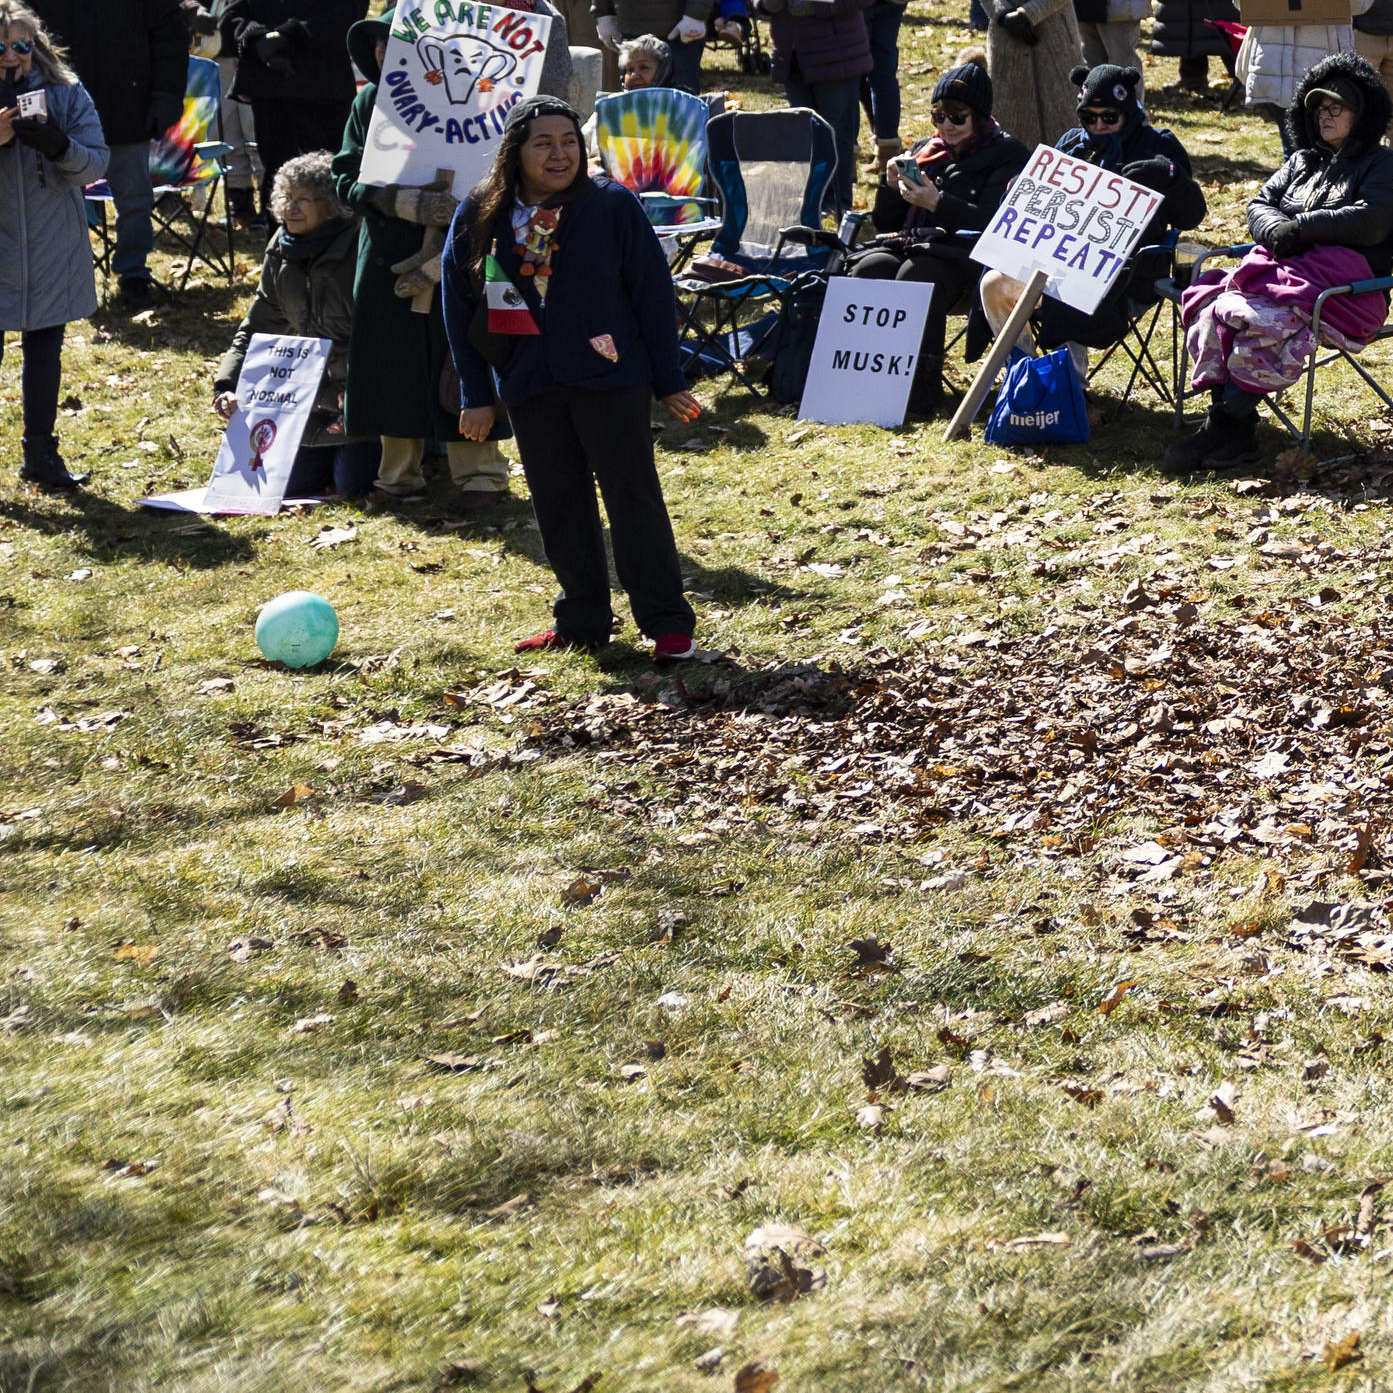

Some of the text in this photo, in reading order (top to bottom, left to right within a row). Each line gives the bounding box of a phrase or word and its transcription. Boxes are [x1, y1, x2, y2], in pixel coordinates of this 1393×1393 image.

[391, 7, 431, 45] WE
[493, 11, 546, 60] NOT
[1029, 149, 1158, 224] RESIST!
[1009, 177, 1140, 253] PERSIST!
[992, 208, 1123, 283] REPEAT!
[843, 303, 907, 329] STOP
[267, 345, 310, 360] THIS IS
[832, 350, 914, 376] MUSK!
[270, 366, 296, 379] NOT
[249, 390, 298, 404] NORMAL
[1010, 410, 1060, 429] meijer
